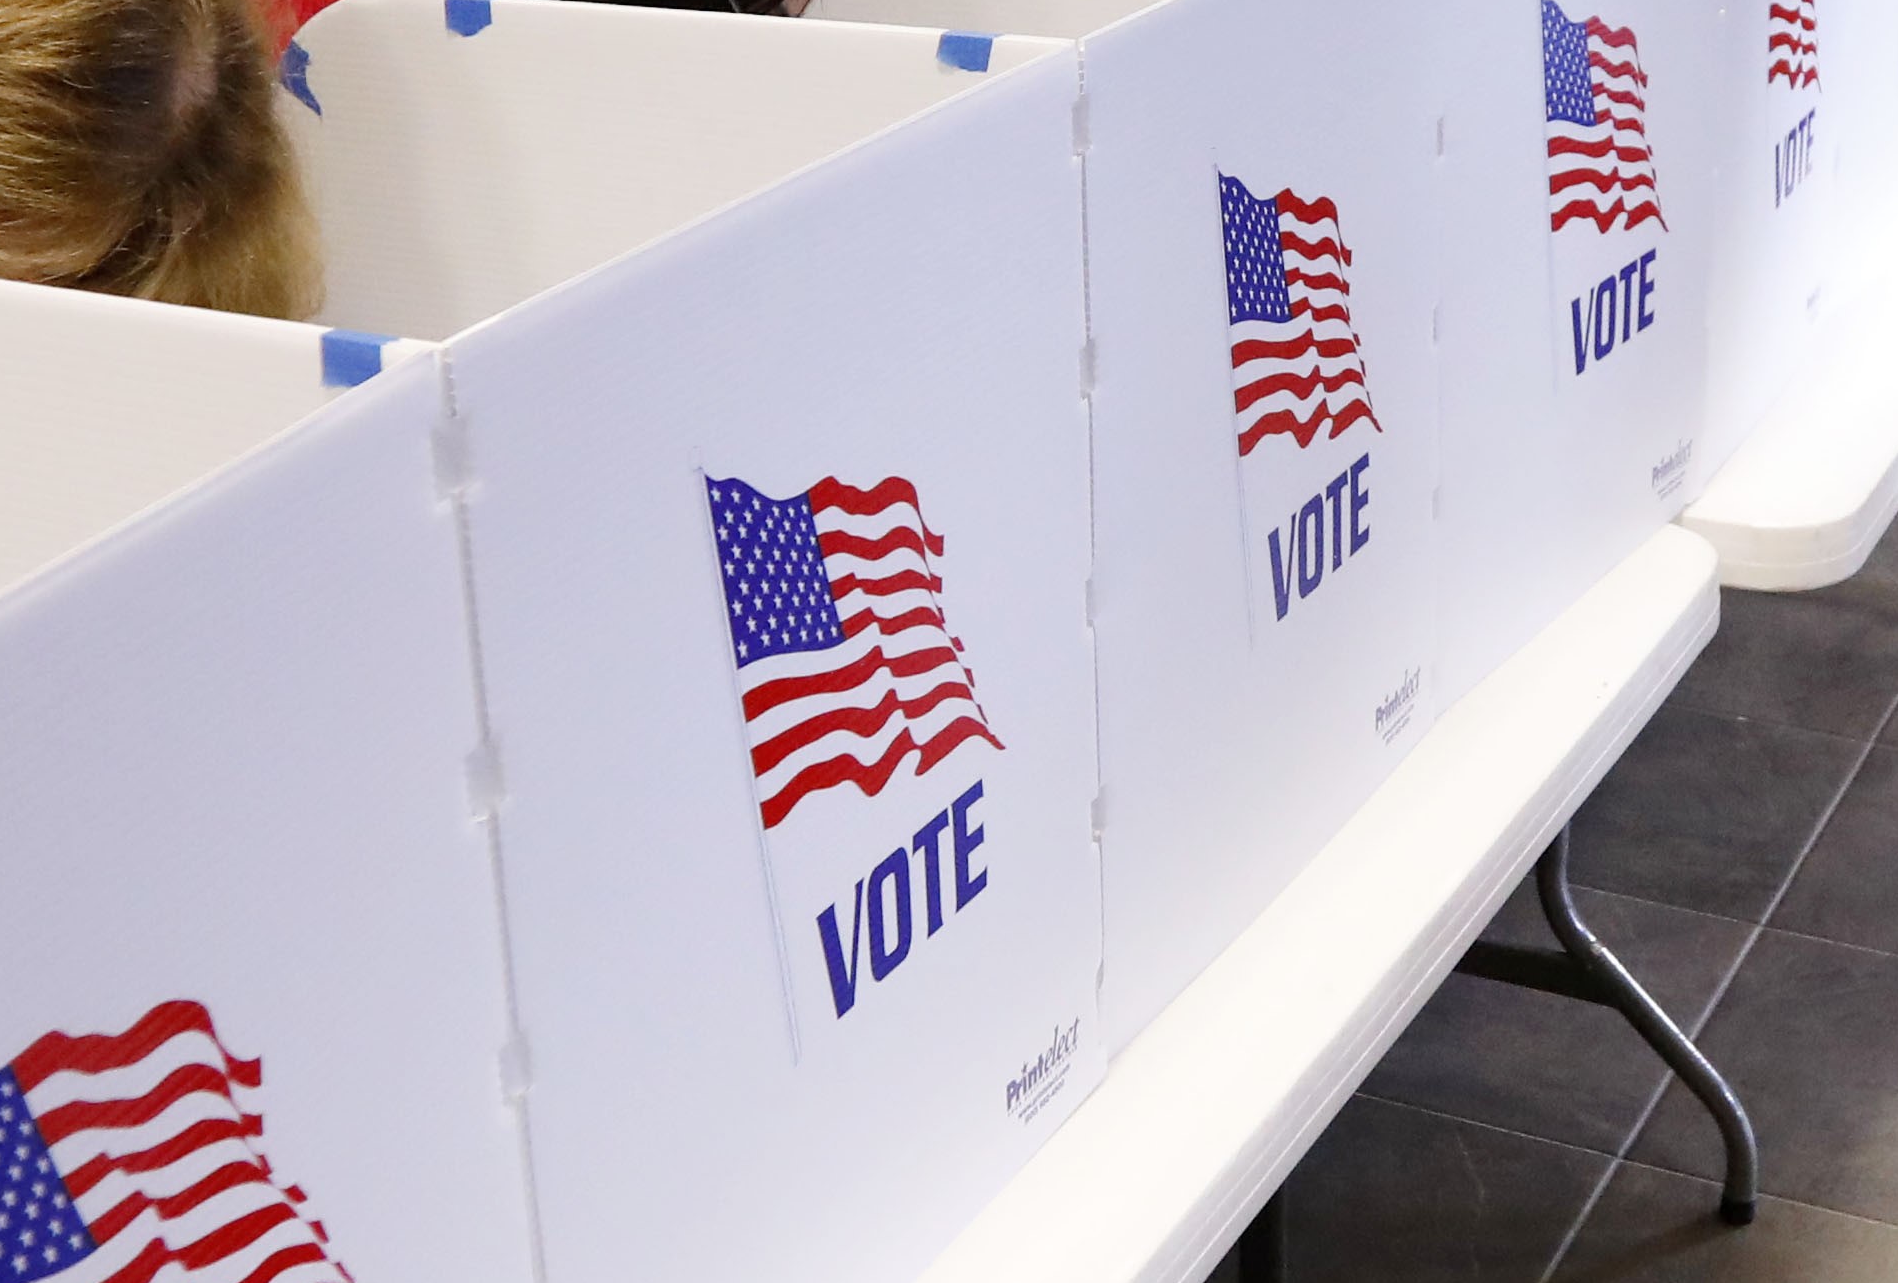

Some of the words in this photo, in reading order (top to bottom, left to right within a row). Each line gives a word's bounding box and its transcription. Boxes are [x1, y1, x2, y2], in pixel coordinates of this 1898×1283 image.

[1775, 107, 1815, 209] VOTE
[1571, 248, 1657, 376] VOTE
[1268, 452, 1370, 622] VOTE
[816, 778, 988, 1020] VOTE
[1006, 1015, 1080, 1112] Printelect
